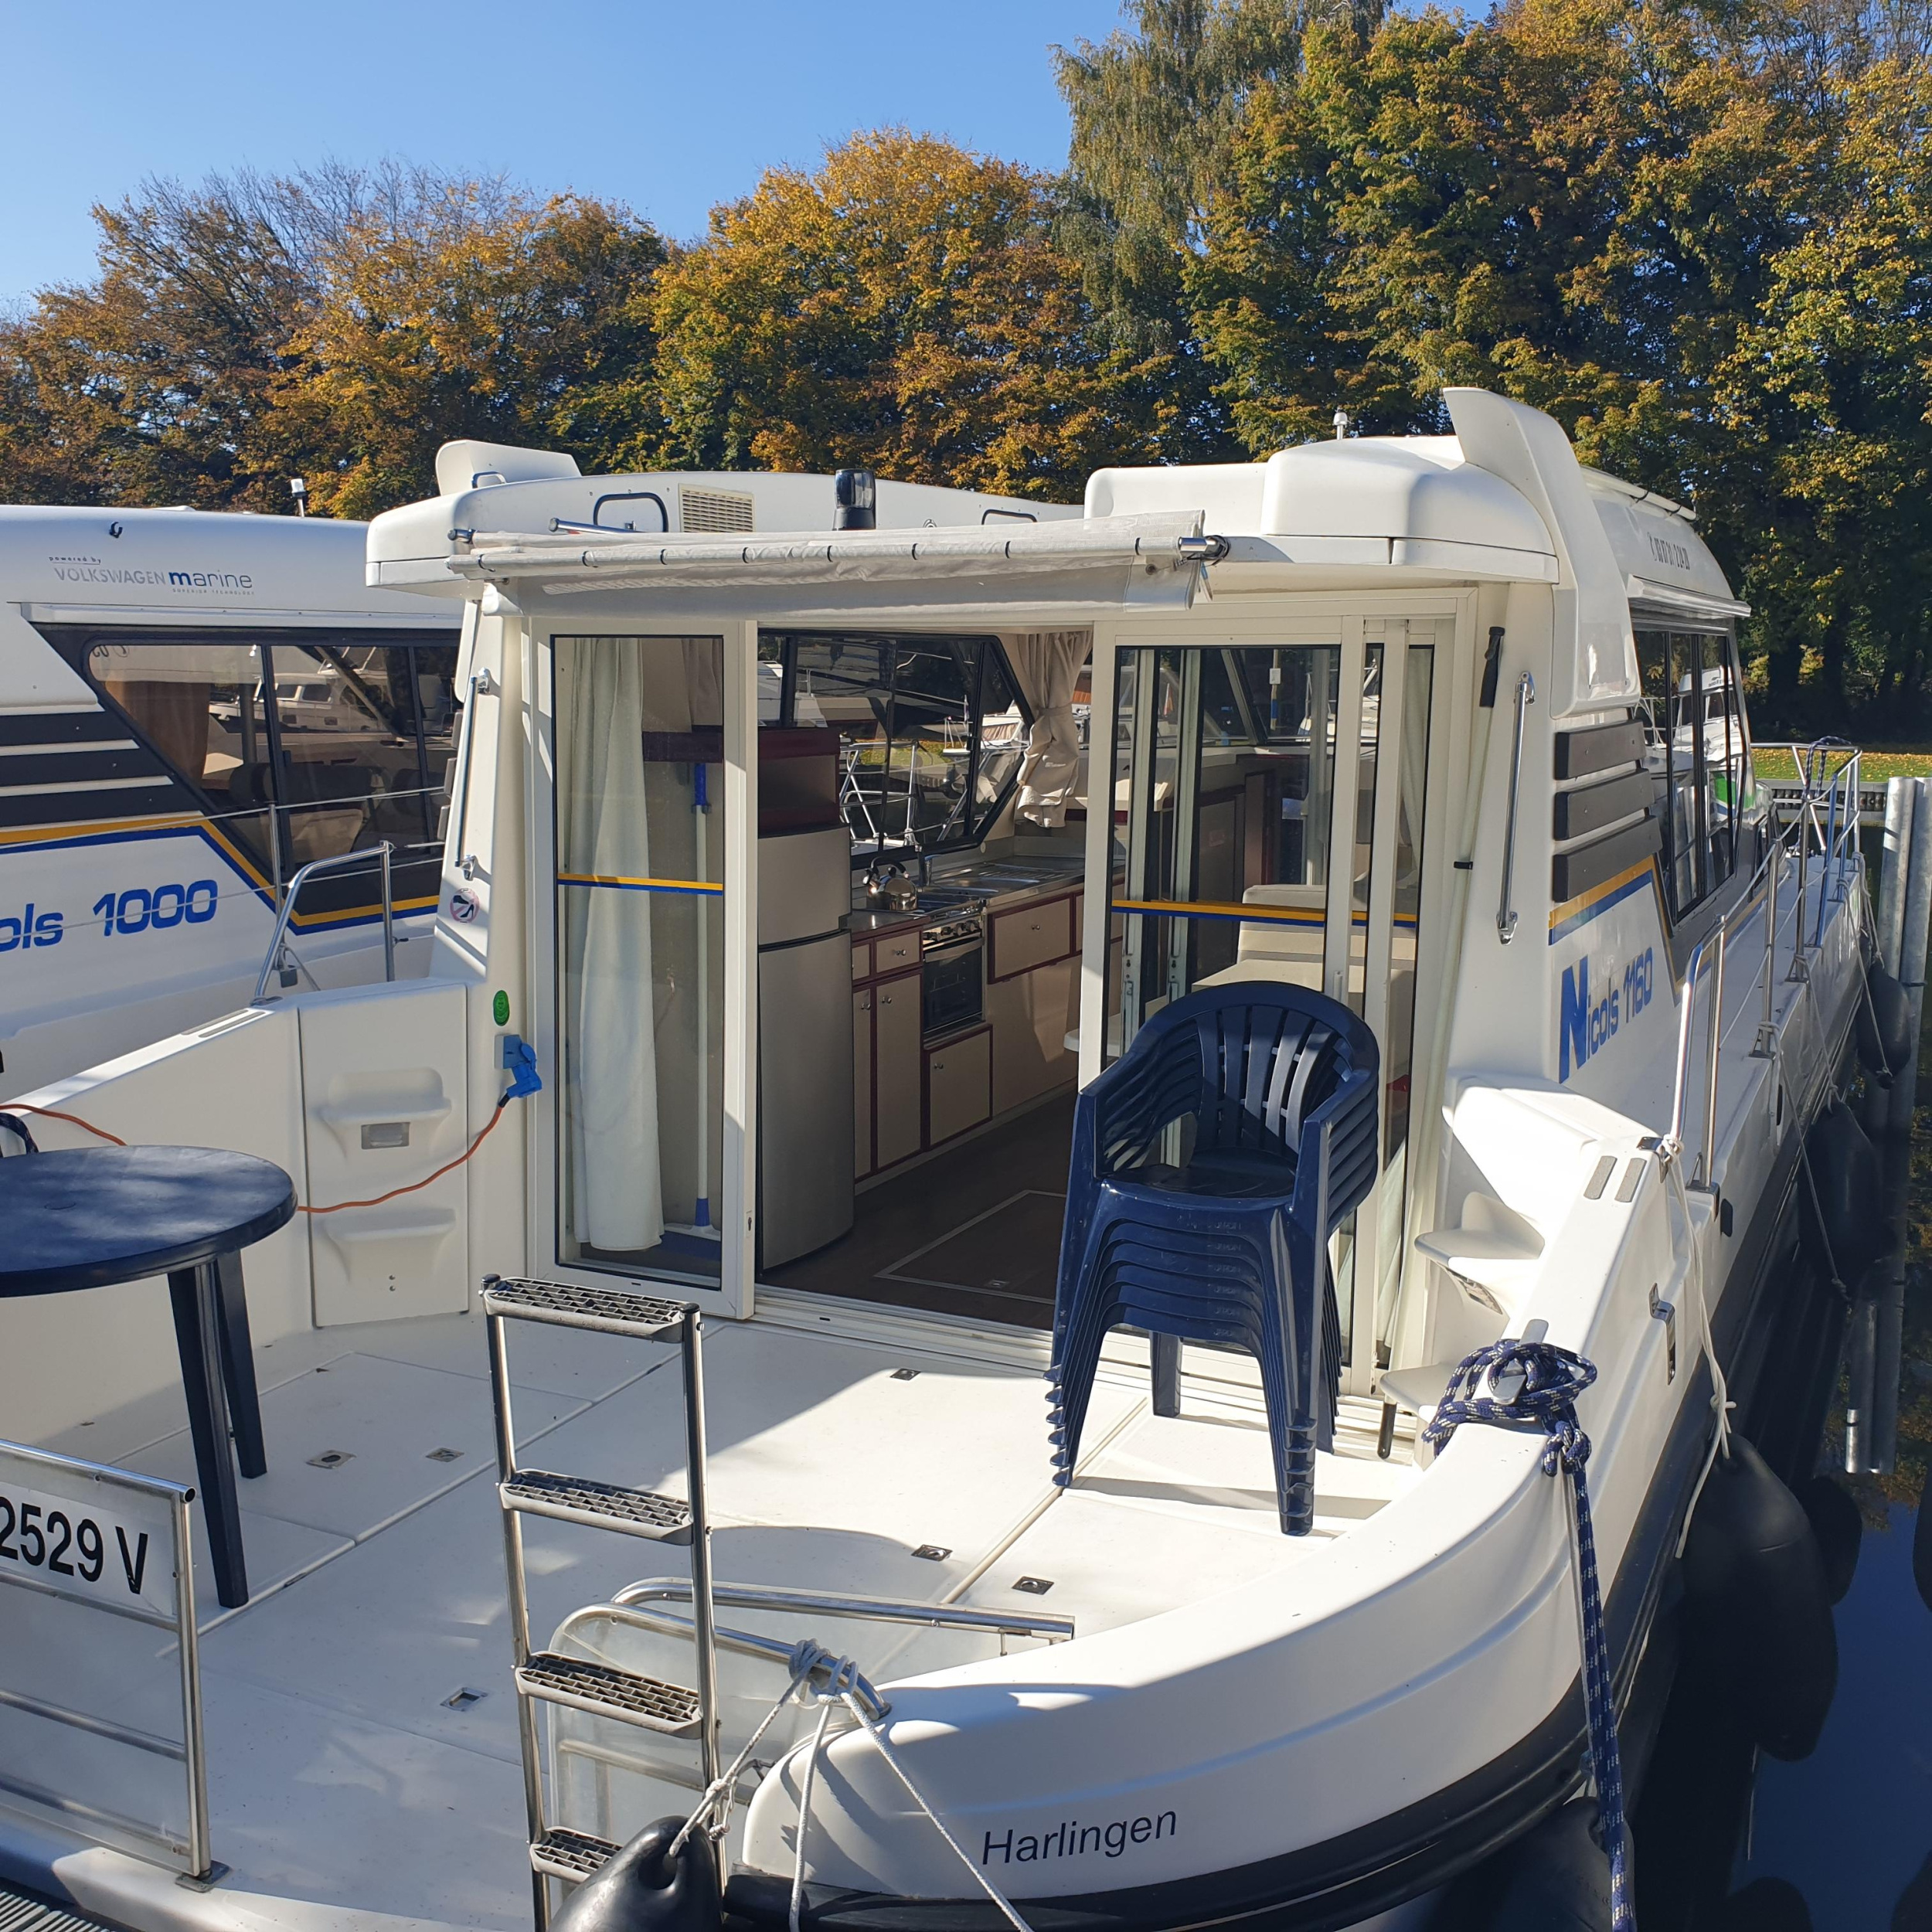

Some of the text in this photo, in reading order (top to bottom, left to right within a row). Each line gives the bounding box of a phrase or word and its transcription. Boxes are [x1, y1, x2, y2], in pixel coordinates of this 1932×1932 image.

[54, 567, 253, 588] VOLKSWAGEN marine
[92, 879, 218, 937] 1000
[1558, 947, 1653, 1085] Nicols 1160
[115, 1526, 148, 1595] V
[981, 1810, 1176, 1866] Harlingen
